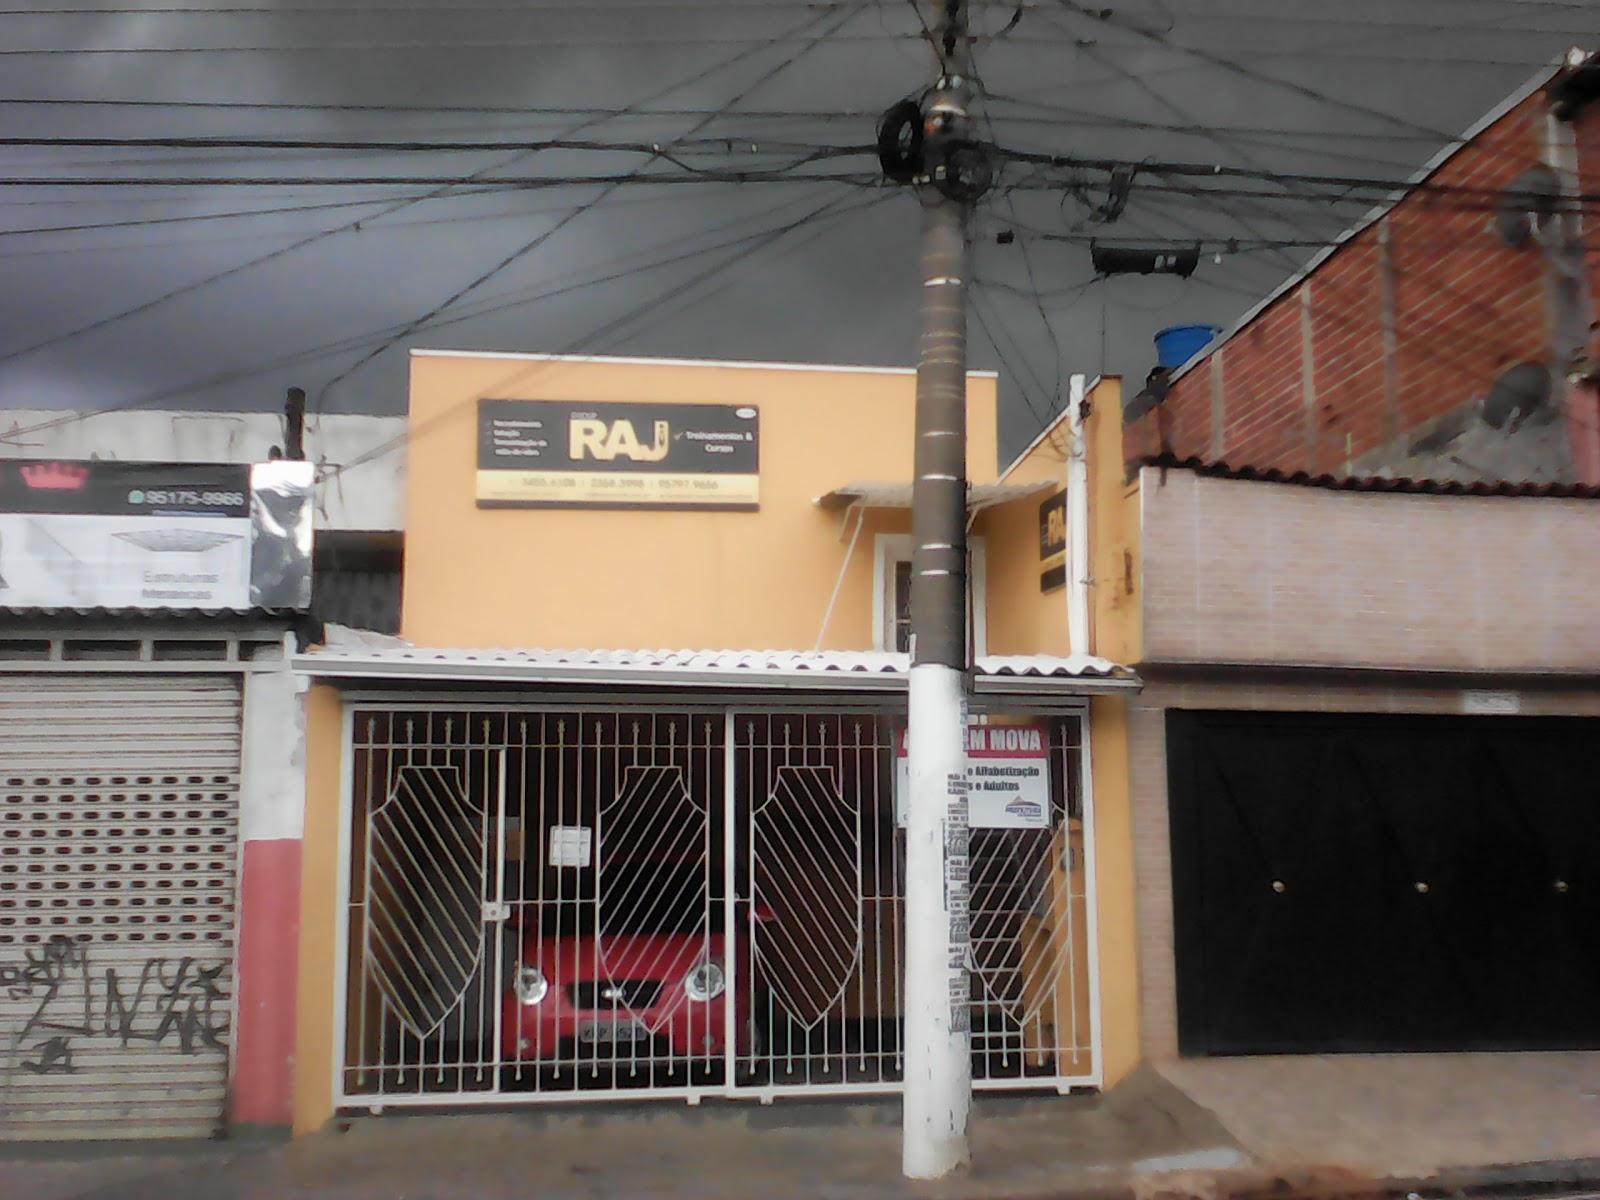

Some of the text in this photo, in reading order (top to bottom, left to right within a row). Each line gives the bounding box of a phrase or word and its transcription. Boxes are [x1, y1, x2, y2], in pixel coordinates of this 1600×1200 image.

[570, 419, 669, 462] RAJ
[990, 729, 1041, 751] MOVA
[975, 765, 1040, 778] Alfabetização
[983, 780, 1020, 791] Adultos
